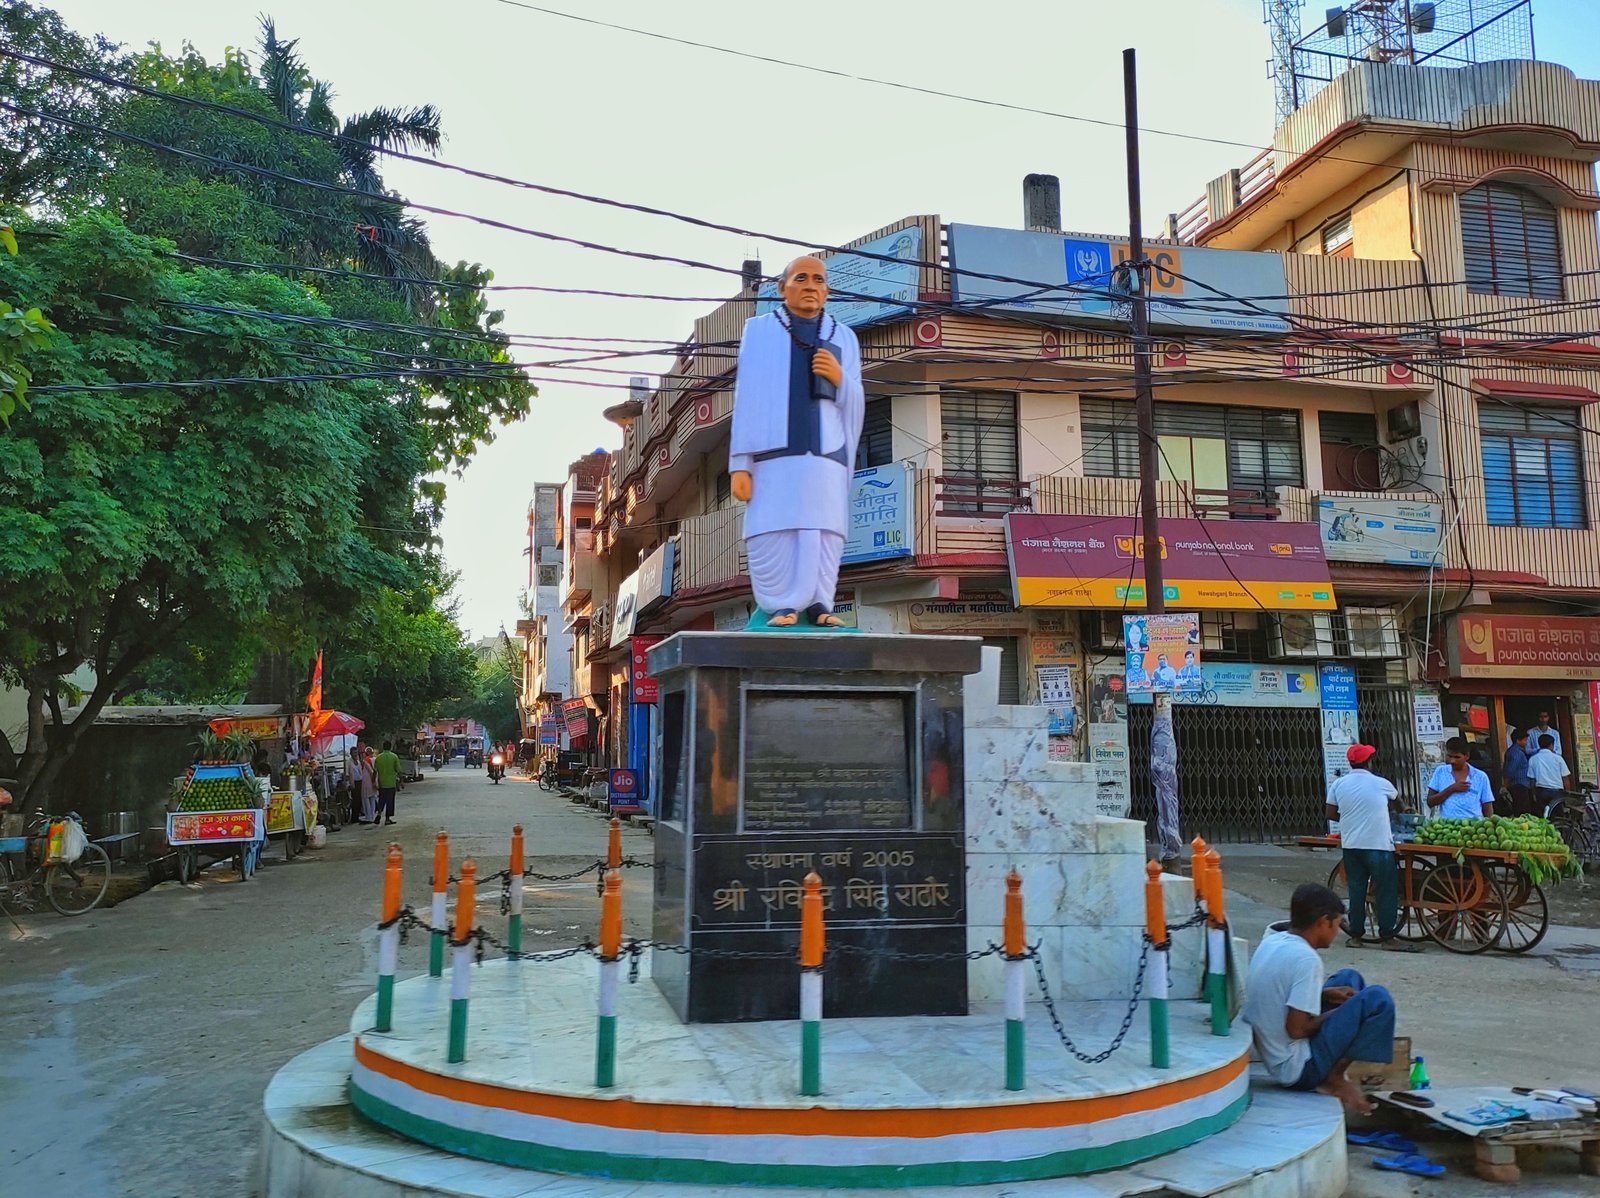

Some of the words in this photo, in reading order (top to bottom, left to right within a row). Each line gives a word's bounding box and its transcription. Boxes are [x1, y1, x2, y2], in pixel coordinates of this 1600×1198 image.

[1210, 318, 1236, 326] SATELLITE
[853, 492, 899, 508] जीवन
[852, 504, 898, 524] शांति
[886, 530, 901, 544] LIC
[1021, 537, 1050, 548] पंजाब
[1088, 537, 1105, 549] बैंक
[1175, 540, 1203, 551] punjab
[1203, 541, 1235, 550] national
[1235, 541, 1255, 551] bank
[1498, 647, 1537, 663] punjab
[1538, 648, 1584, 661] national
[614, 775, 633, 786] Jio
[199, 816, 213, 824] राज
[215, 816, 229, 824] जूस
[746, 853, 815, 870] स्थापना
[820, 848, 853, 868] वर्ष
[862, 850, 915, 868] 2005
[713, 880, 749, 912] श्री
[843, 878, 889, 911] सिंह
[895, 876, 950, 907] राठौर
